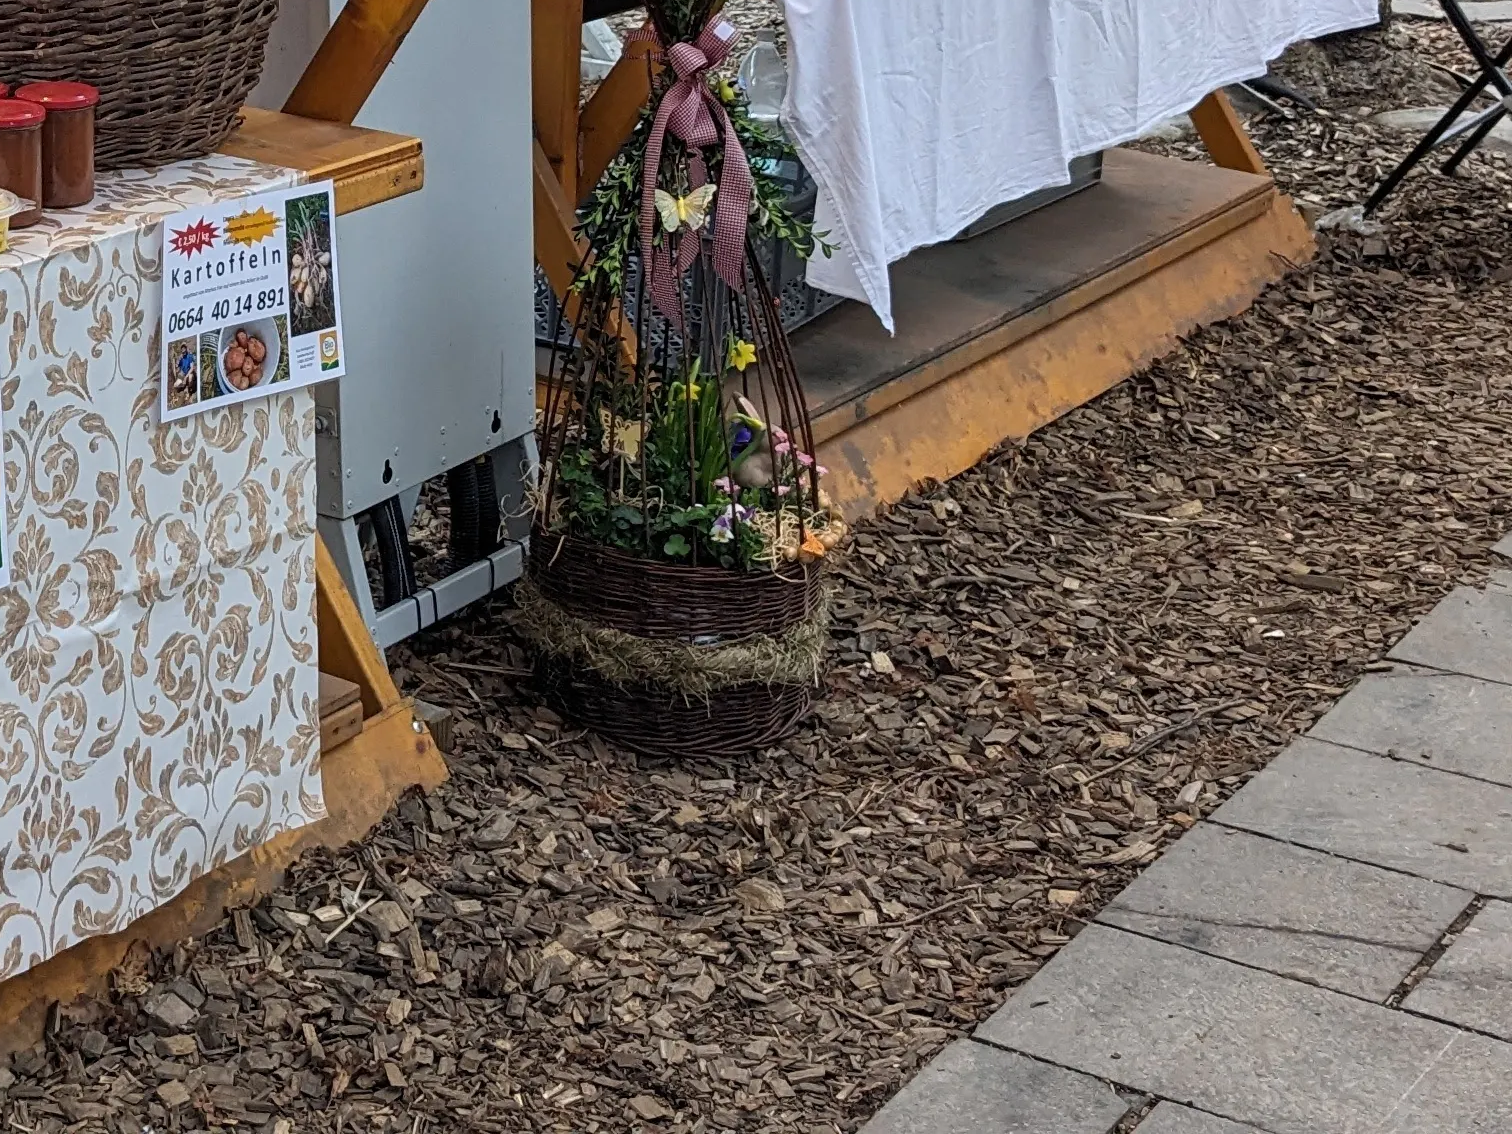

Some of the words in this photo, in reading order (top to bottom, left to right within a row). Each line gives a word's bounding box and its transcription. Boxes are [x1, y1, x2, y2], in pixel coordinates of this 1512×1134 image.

[171, 246, 281, 289] Kartoffeln
[169, 306, 204, 333] 0664
[211, 299, 230, 321] 40
[234, 294, 252, 316] 14
[257, 287, 285, 310] 891
